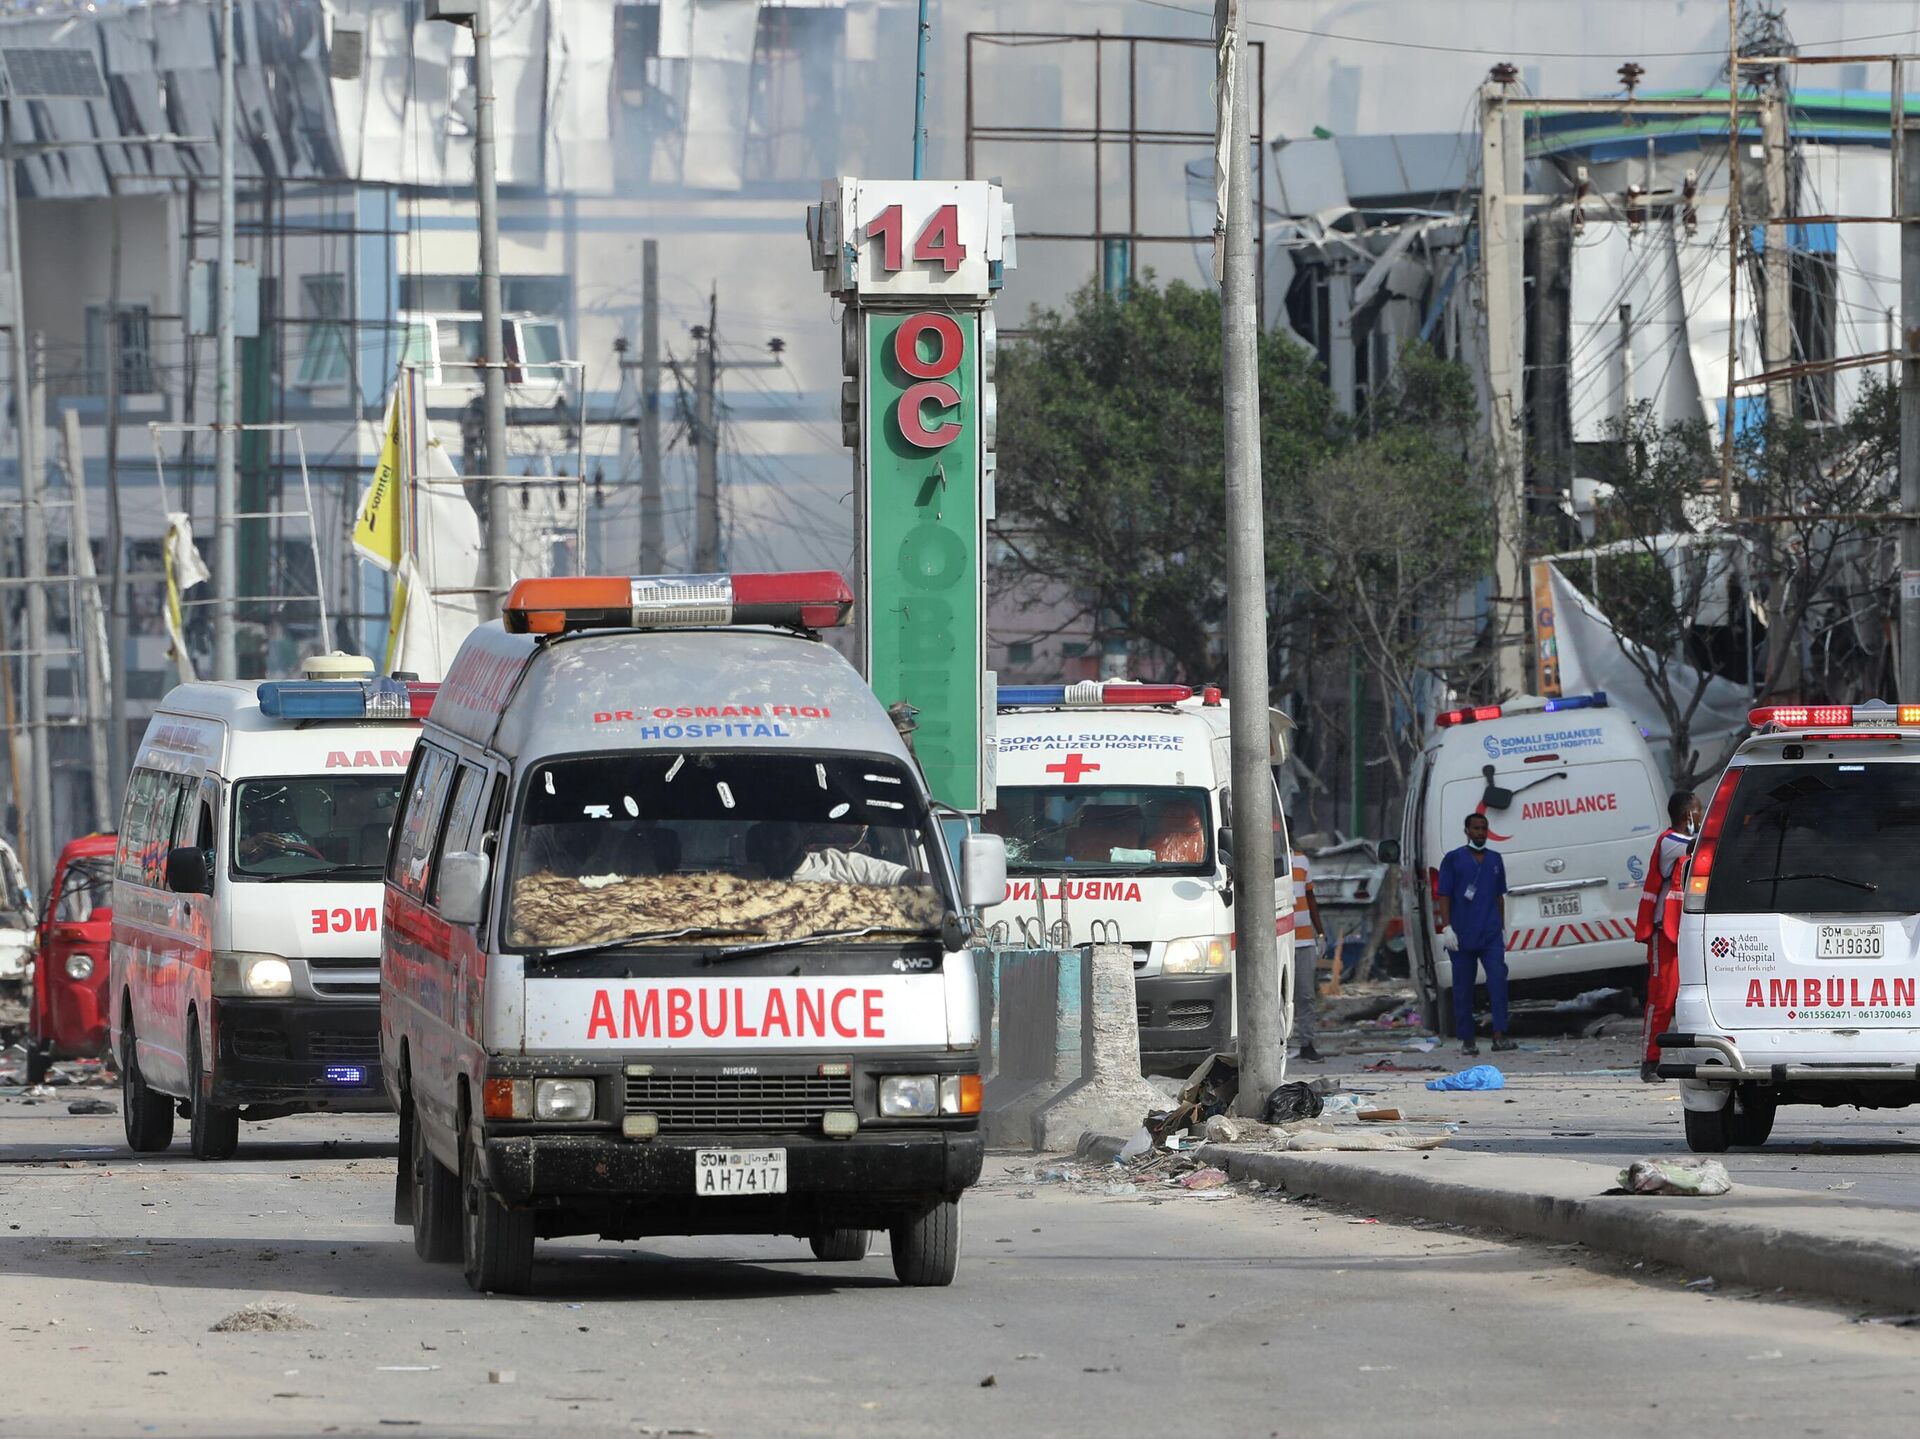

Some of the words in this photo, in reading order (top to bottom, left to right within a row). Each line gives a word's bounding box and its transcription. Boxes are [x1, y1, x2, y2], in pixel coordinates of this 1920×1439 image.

[867, 204, 967, 272] 14
[371, 464, 392, 511] somtel
[594, 710, 642, 724] DR.
[653, 706, 762, 719] OSMAN
[773, 706, 832, 719] FIQI
[641, 723, 790, 740] HOSPITAL
[1501, 735, 1542, 747] SOMALI
[1544, 728, 1602, 741] SUDANESE
[1000, 734, 1073, 745] SOMALI
[1079, 734, 1184, 744] SUDANESE
[1105, 742, 1184, 751] HOSPITAL
[1502, 743, 1559, 755] SPECIALIZED
[1560, 738, 1604, 749] HOSPITAL
[1521, 793, 1618, 820] AMBULANCE
[1738, 934, 1758, 942] Aden
[1822, 927, 1842, 938] SOM
[1738, 943, 1769, 951] Abdulle
[1738, 952, 1775, 964] Hospital
[587, 988, 885, 1039] AMBULANCE
[1798, 1011, 1851, 1019] 0615562471
[1858, 1011, 1912, 1019] 0613700463
[723, 1066, 758, 1075] NISSAN
[701, 1153, 728, 1167] SOM
[703, 1167, 780, 1191] AH7417
